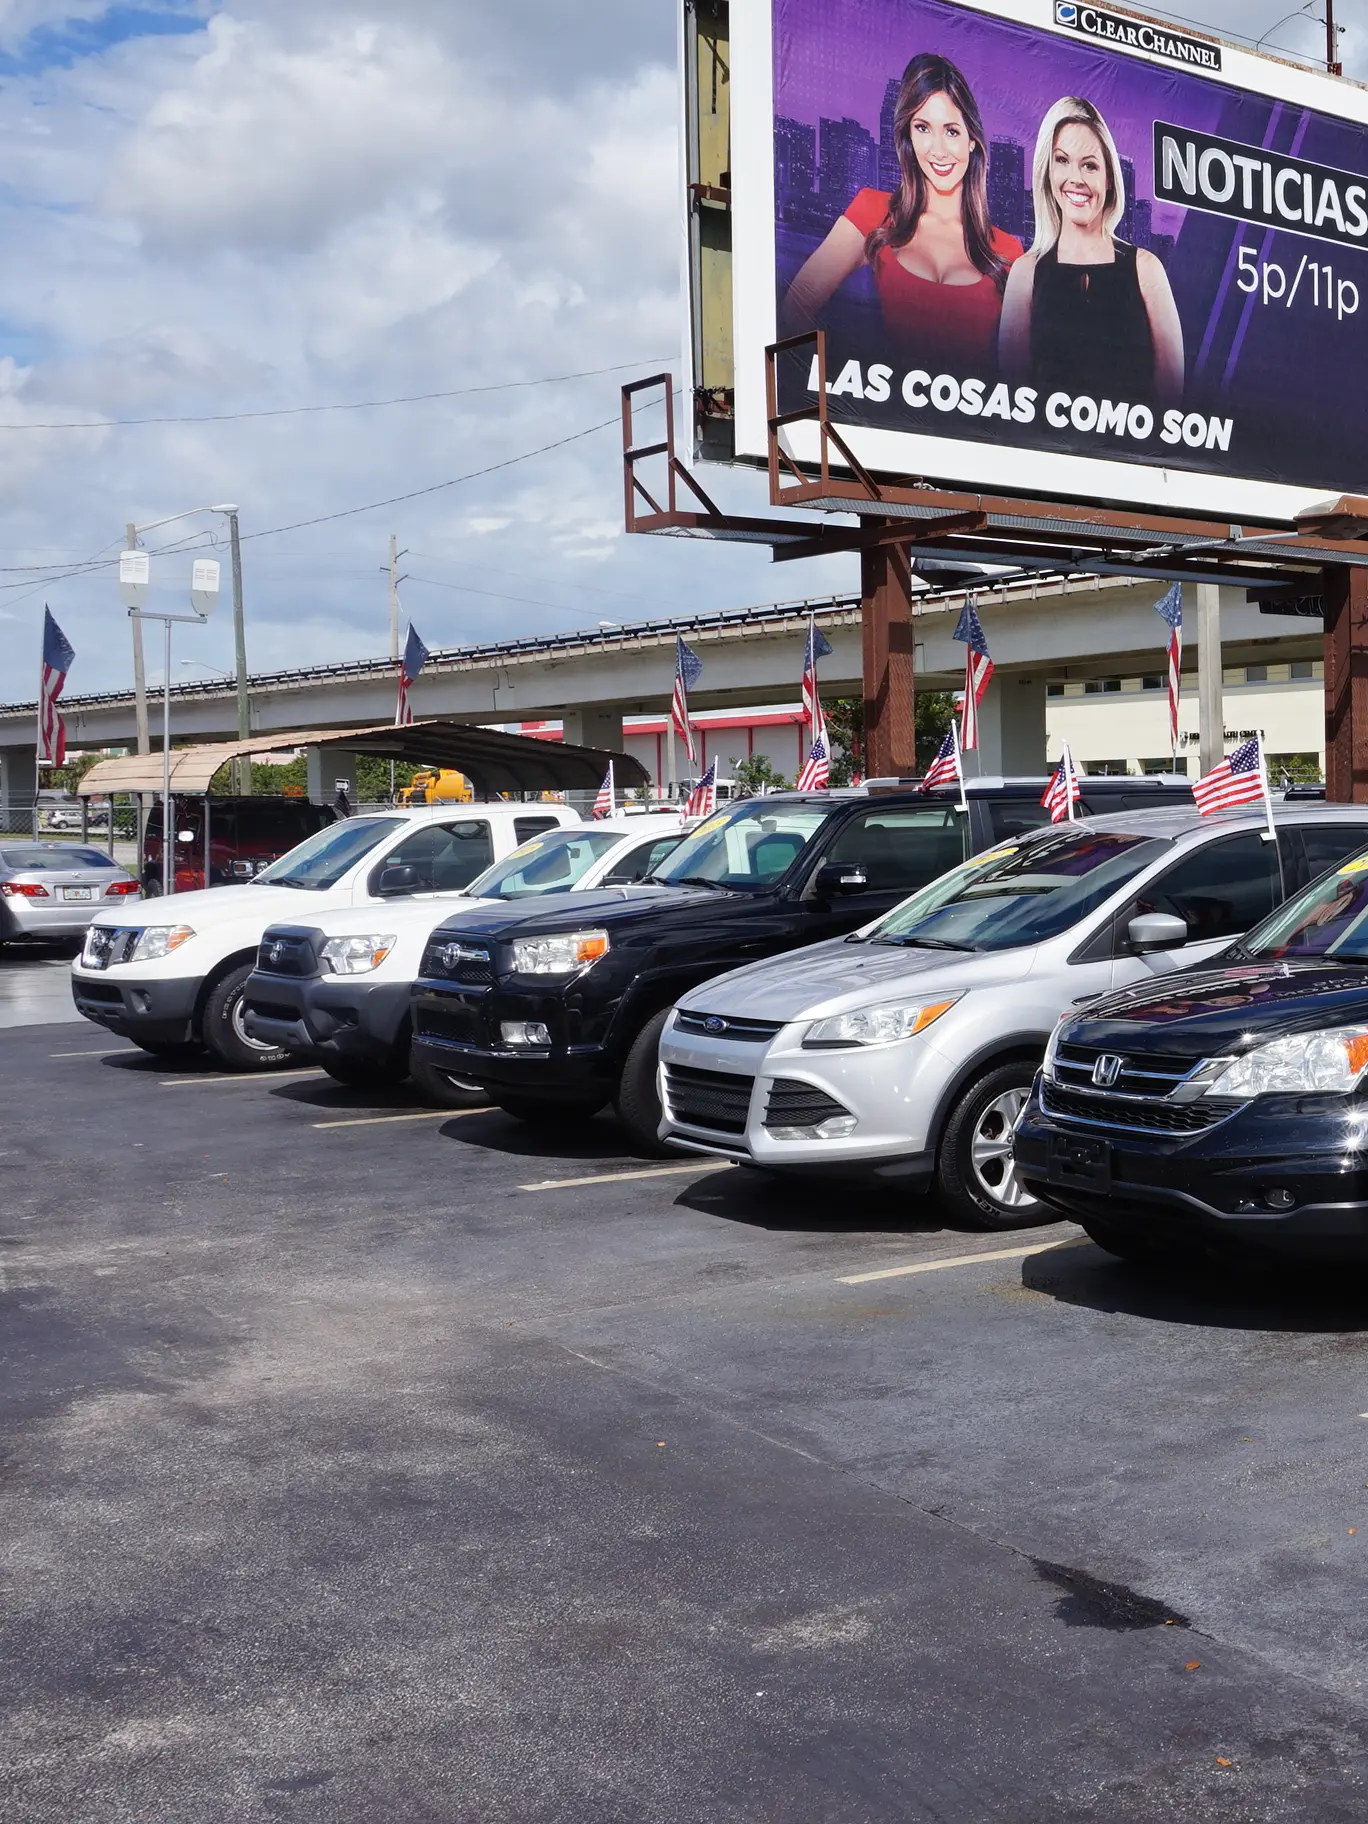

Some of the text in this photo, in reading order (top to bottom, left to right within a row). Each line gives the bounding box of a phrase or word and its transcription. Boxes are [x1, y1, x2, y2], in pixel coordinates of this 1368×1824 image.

[1162, 136, 1368, 237] NOTICIAS
[1236, 245, 1360, 321] 5p/11p
[806, 353, 1235, 452] LAS COSAS COMO SON
